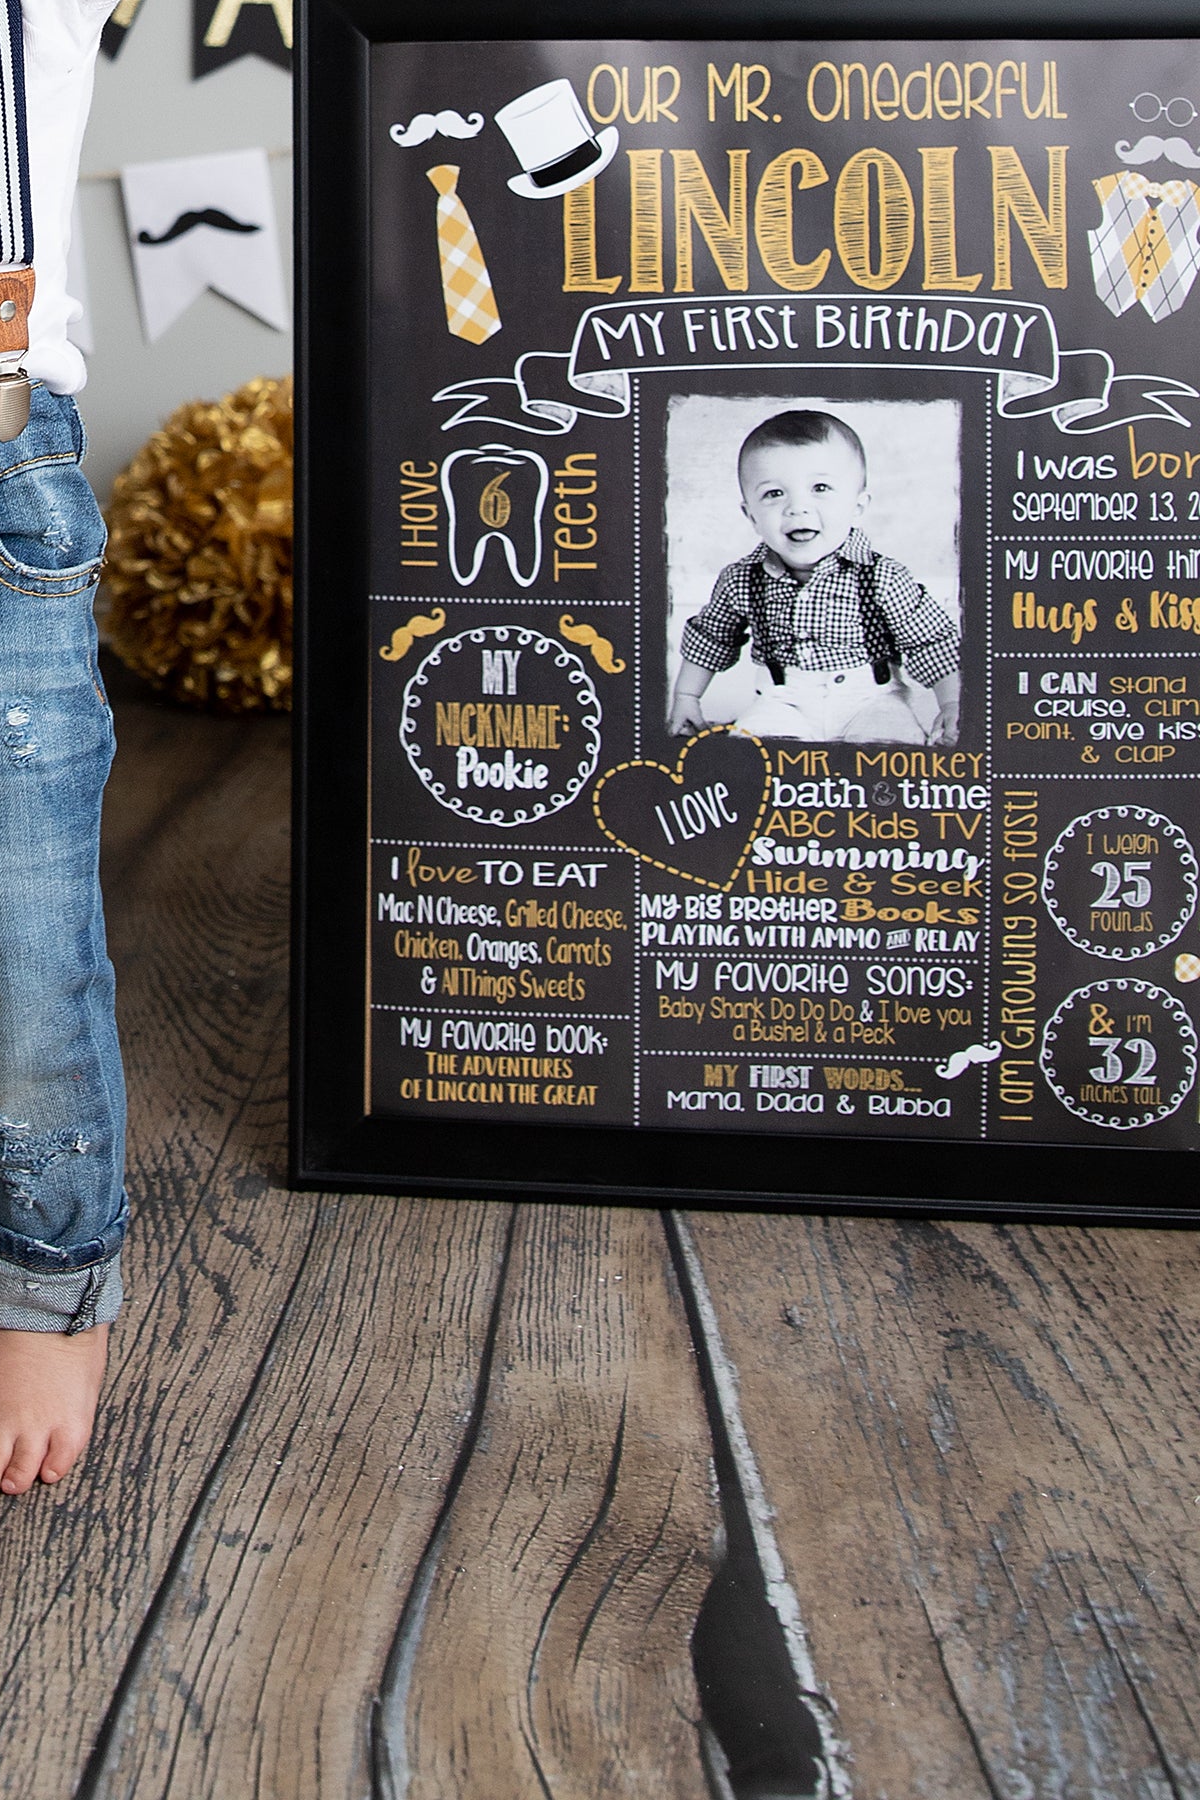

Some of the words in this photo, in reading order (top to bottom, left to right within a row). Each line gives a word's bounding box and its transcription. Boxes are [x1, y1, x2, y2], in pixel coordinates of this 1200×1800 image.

[587, 63, 681, 124] OUR
[707, 62, 782, 123] MR.
[562, 145, 1069, 294] LINCOLN
[591, 310, 666, 360] MY
[1017, 450, 1024, 480] I
[1033, 455, 1118, 480] was
[479, 471, 511, 529] 6
[554, 453, 598, 583] Teeth
[1012, 591, 1098, 645] Hugs
[1115, 597, 1139, 634] &
[482, 649, 522, 696] MY
[1018, 671, 1029, 695] I
[1040, 671, 1098, 695] CAN
[435, 702, 570, 750] NICKNAME:
[456, 745, 549, 790] Pookie
[777, 750, 841, 777] MR.
[1081, 745, 1100, 763] &
[772, 777, 868, 808] bath
[898, 778, 988, 810] time
[764, 810, 836, 838] ABC
[848, 811, 920, 839] Kids
[931, 812, 984, 840] TV
[751, 836, 985, 881] Swimming
[1086, 833, 1094, 855] I
[391, 856, 399, 881] I
[405, 847, 479, 888] love
[476, 860, 524, 886] TO
[533, 861, 608, 888] EAT
[747, 869, 829, 894] Hide
[843, 872, 877, 895] &
[890, 872, 984, 898] Seek
[1090, 861, 1152, 909] 25
[378, 892, 415, 922] Mac
[417, 894, 434, 924] N
[505, 898, 558, 929] Grilled
[839, 898, 981, 925] Books
[546, 936, 612, 967] Carrots
[641, 921, 740, 948] PLAYING
[744, 924, 806, 948] WITH
[810, 927, 881, 950] AMMO
[886, 929, 911, 949] AND
[914, 928, 981, 952] RELAY
[420, 965, 438, 995] &
[519, 968, 586, 1002] Sweets
[658, 995, 706, 1024] Baby
[710, 995, 766, 1020] Shark
[770, 996, 796, 1021] Do
[800, 997, 825, 1021] Do
[830, 998, 855, 1022] Do
[859, 999, 874, 1023] &
[878, 1000, 889, 1024] I
[894, 1000, 932, 1025] love
[936, 1006, 973, 1031] you
[1088, 1003, 1115, 1036] &
[732, 1024, 746, 1041] a
[749, 1020, 809, 1043] Bushel
[814, 1022, 828, 1043] &
[833, 1026, 845, 1043] a
[850, 1022, 896, 1045] Peck
[425, 1051, 459, 1076] THE
[462, 1055, 573, 1079] ADVENTURES
[703, 1064, 739, 1088] MY
[749, 1064, 814, 1089] FIRST
[1088, 1036, 1157, 1085] 32
[400, 1078, 424, 1100] OF
[426, 1079, 504, 1103] LINCOLN
[507, 1082, 540, 1104] THE
[543, 1084, 598, 1106] GREAT
[836, 1095, 855, 1115] &
